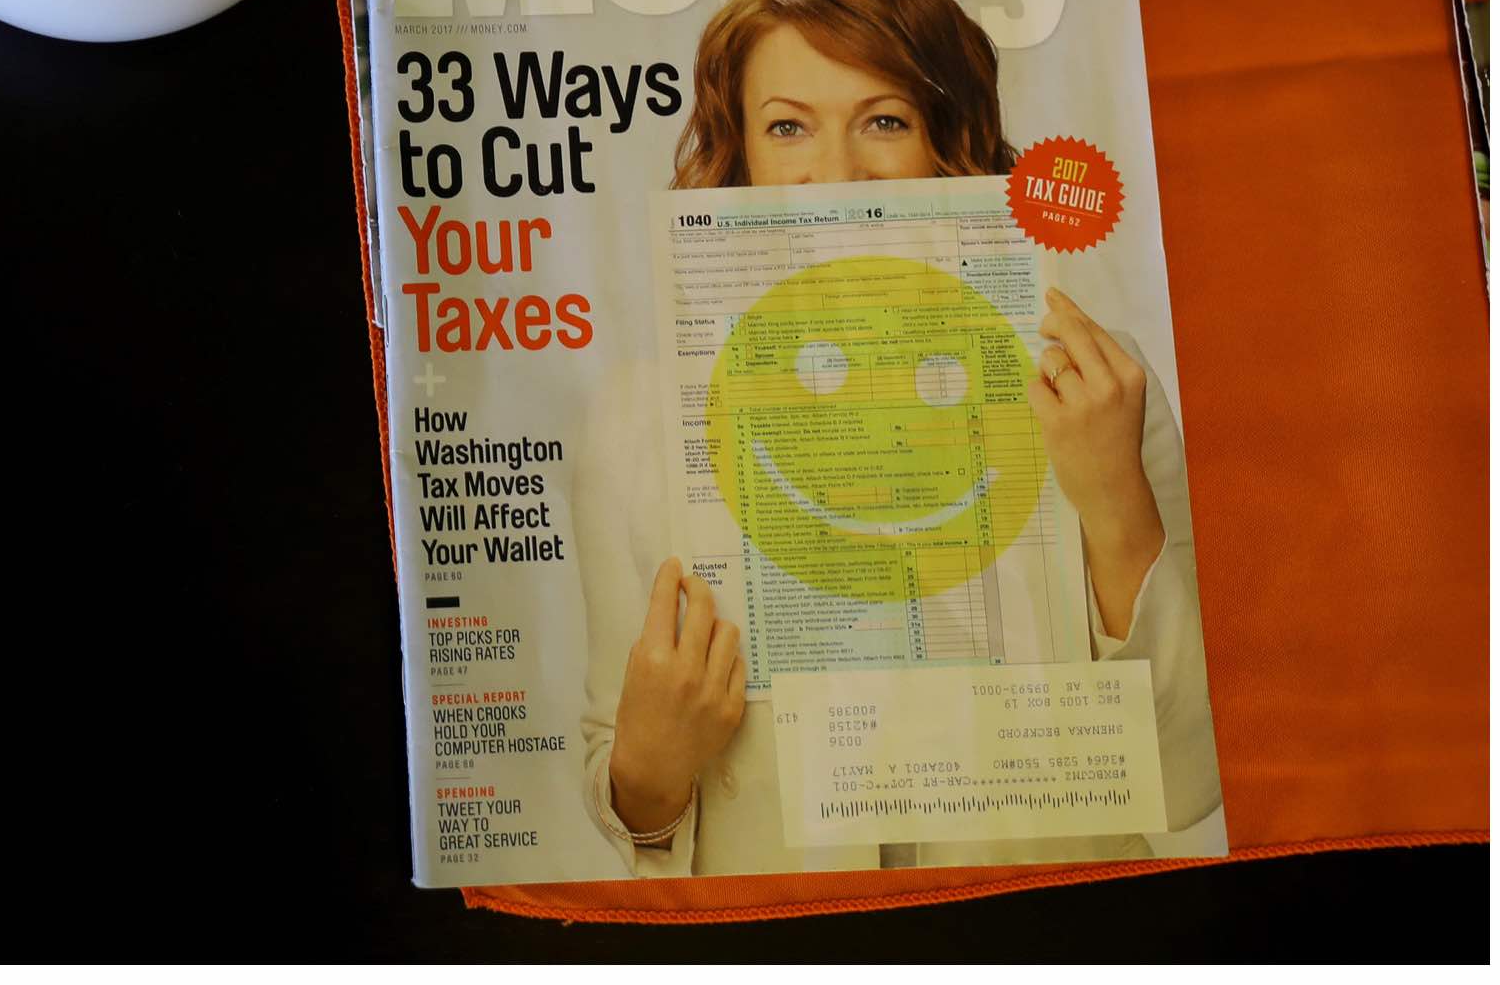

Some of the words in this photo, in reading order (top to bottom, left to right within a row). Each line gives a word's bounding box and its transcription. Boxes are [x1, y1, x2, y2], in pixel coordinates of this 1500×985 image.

[395, 25, 428, 35] MARCH
[432, 25, 452, 35] 2017
[471, 23, 527, 34] MONEY.COM
[397, 51, 475, 123] 33
[493, 51, 682, 134] Ways
[399, 130, 463, 199] to
[482, 126, 595, 198] Cut
[1052, 157, 1088, 183] 2017
[1026, 176, 1055, 202] TAX
[1058, 183, 1106, 213] GUIDE
[679, 214, 711, 227] 1040
[735, 219, 768, 227] Individual
[1042, 210, 1066, 223] PAGE
[397, 205, 552, 276] Your
[402, 282, 593, 353] Taxes
[415, 407, 467, 432] How
[415, 437, 562, 470] Washington
[421, 539, 478, 565] Your
[484, 535, 564, 562] Wallet
[427, 616, 488, 628] INVESTING
[429, 632, 454, 646] TOP
[456, 631, 493, 645] PICKS
[496, 629, 520, 643] FOR
[432, 693, 478, 705] SPECIAL
[483, 691, 526, 702] REPORT
[433, 708, 473, 723] WHEN
[477, 706, 526, 721] CROOKS
[437, 786, 495, 798] SPENDING
